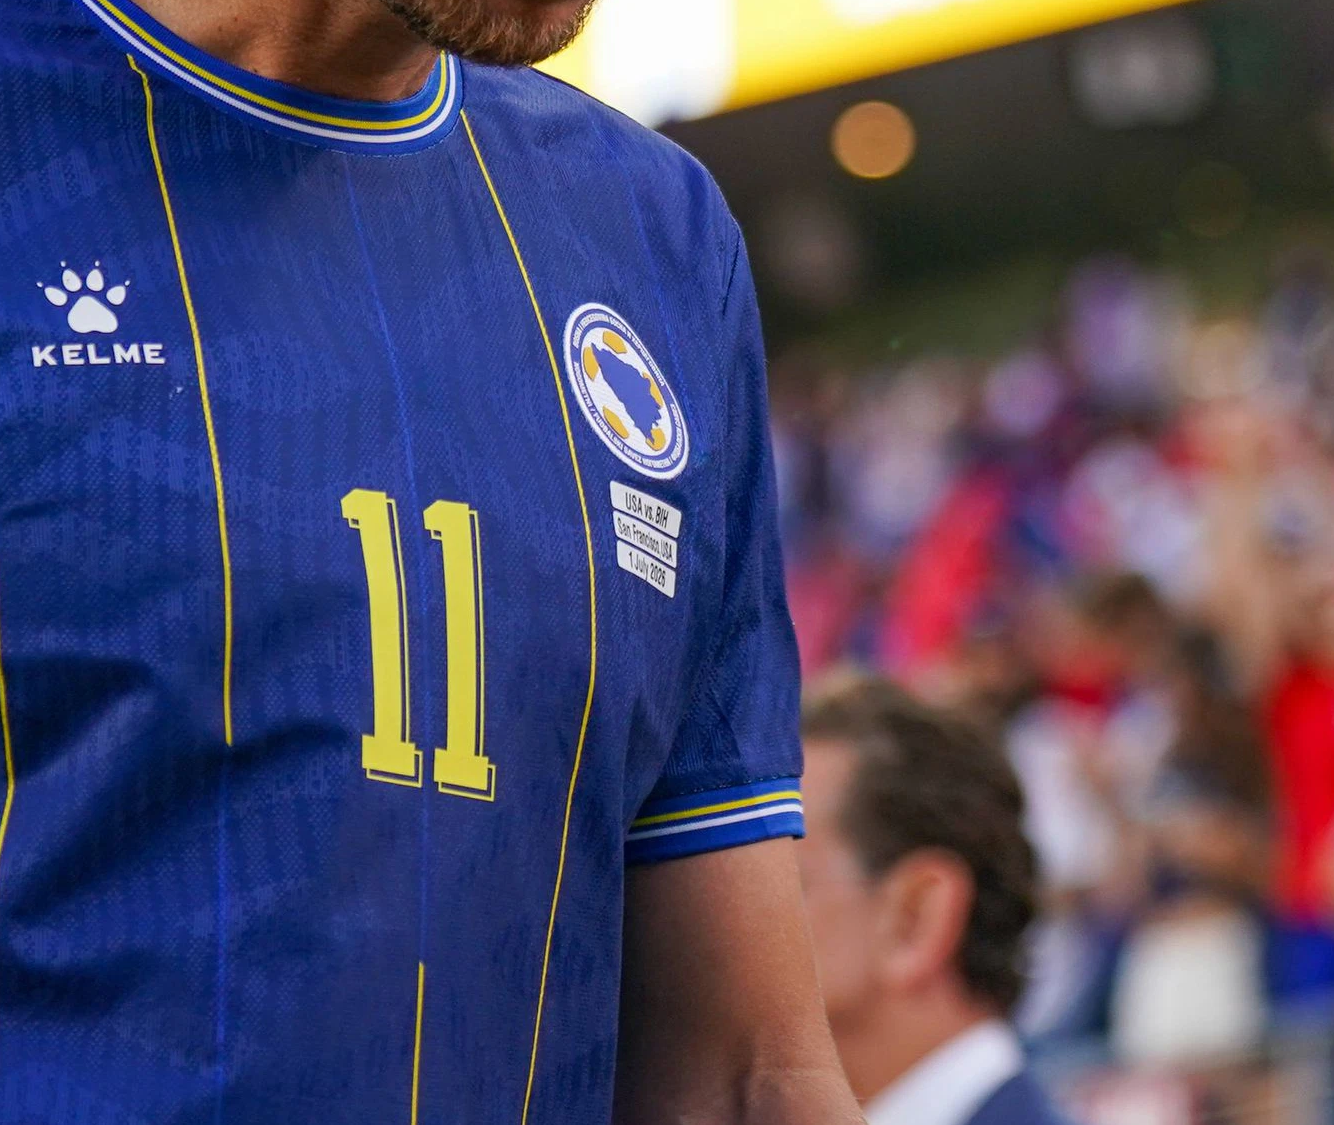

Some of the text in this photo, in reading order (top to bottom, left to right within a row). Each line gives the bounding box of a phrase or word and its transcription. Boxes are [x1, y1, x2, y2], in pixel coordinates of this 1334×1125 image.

[31, 343, 166, 367] KELME
[625, 492, 669, 529] USA vs. BIH
[617, 517, 632, 539] San
[660, 538, 674, 562] USA
[628, 551, 666, 588] 1 July 2026
[340, 487, 497, 803] 11
